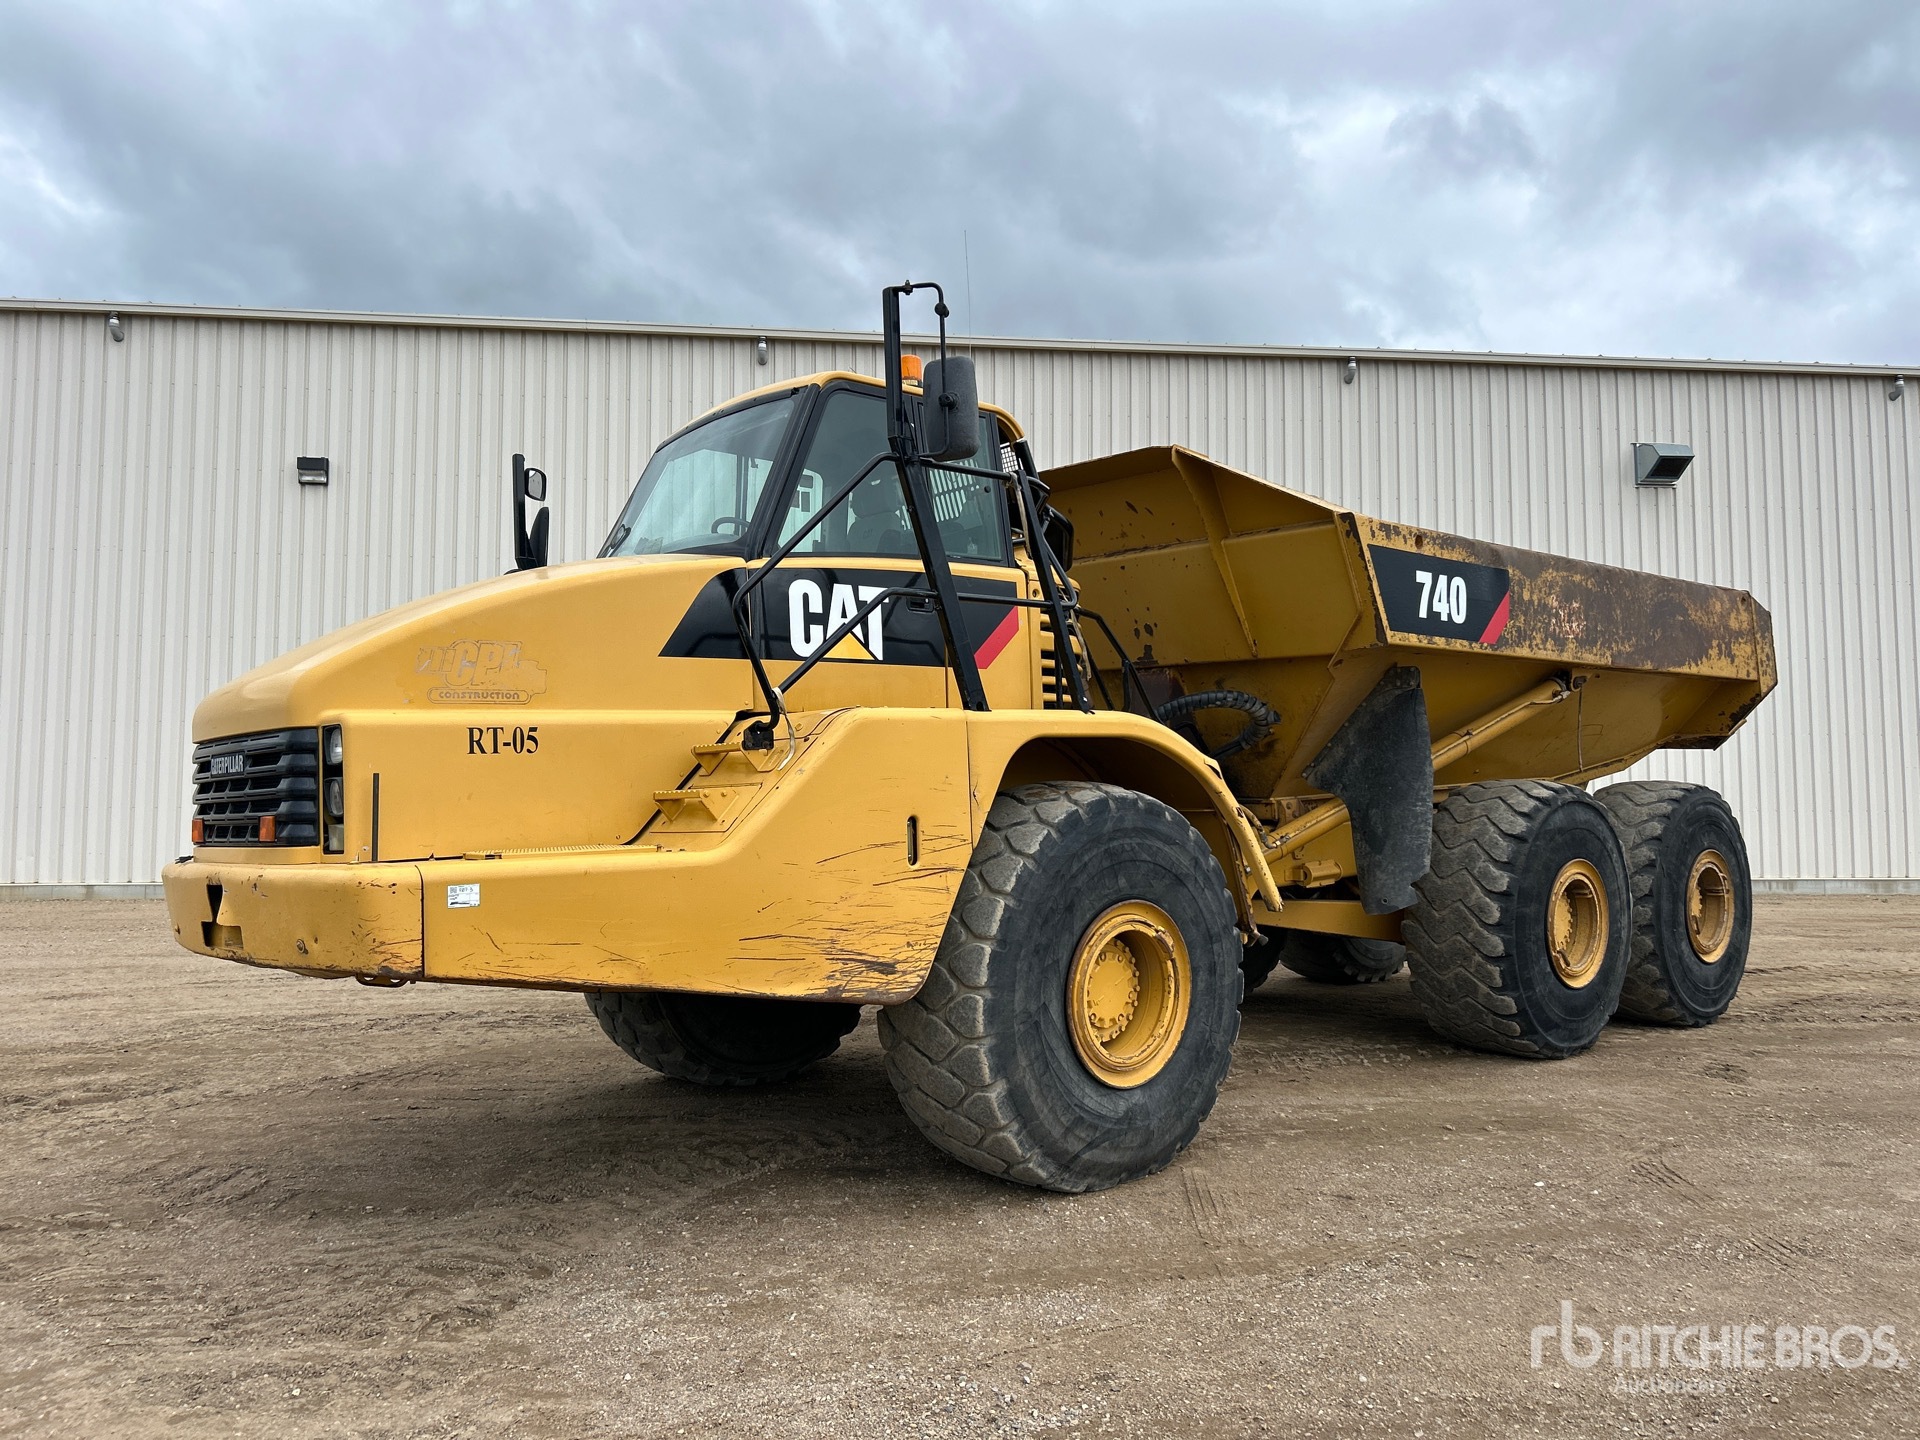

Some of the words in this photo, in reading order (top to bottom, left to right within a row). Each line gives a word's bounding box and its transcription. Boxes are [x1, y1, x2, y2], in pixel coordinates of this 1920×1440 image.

[1415, 570, 1467, 624] 740
[788, 579, 889, 660] CAT
[466, 726, 539, 755] RT-05
[210, 753, 244, 775] CATERPILLAR
